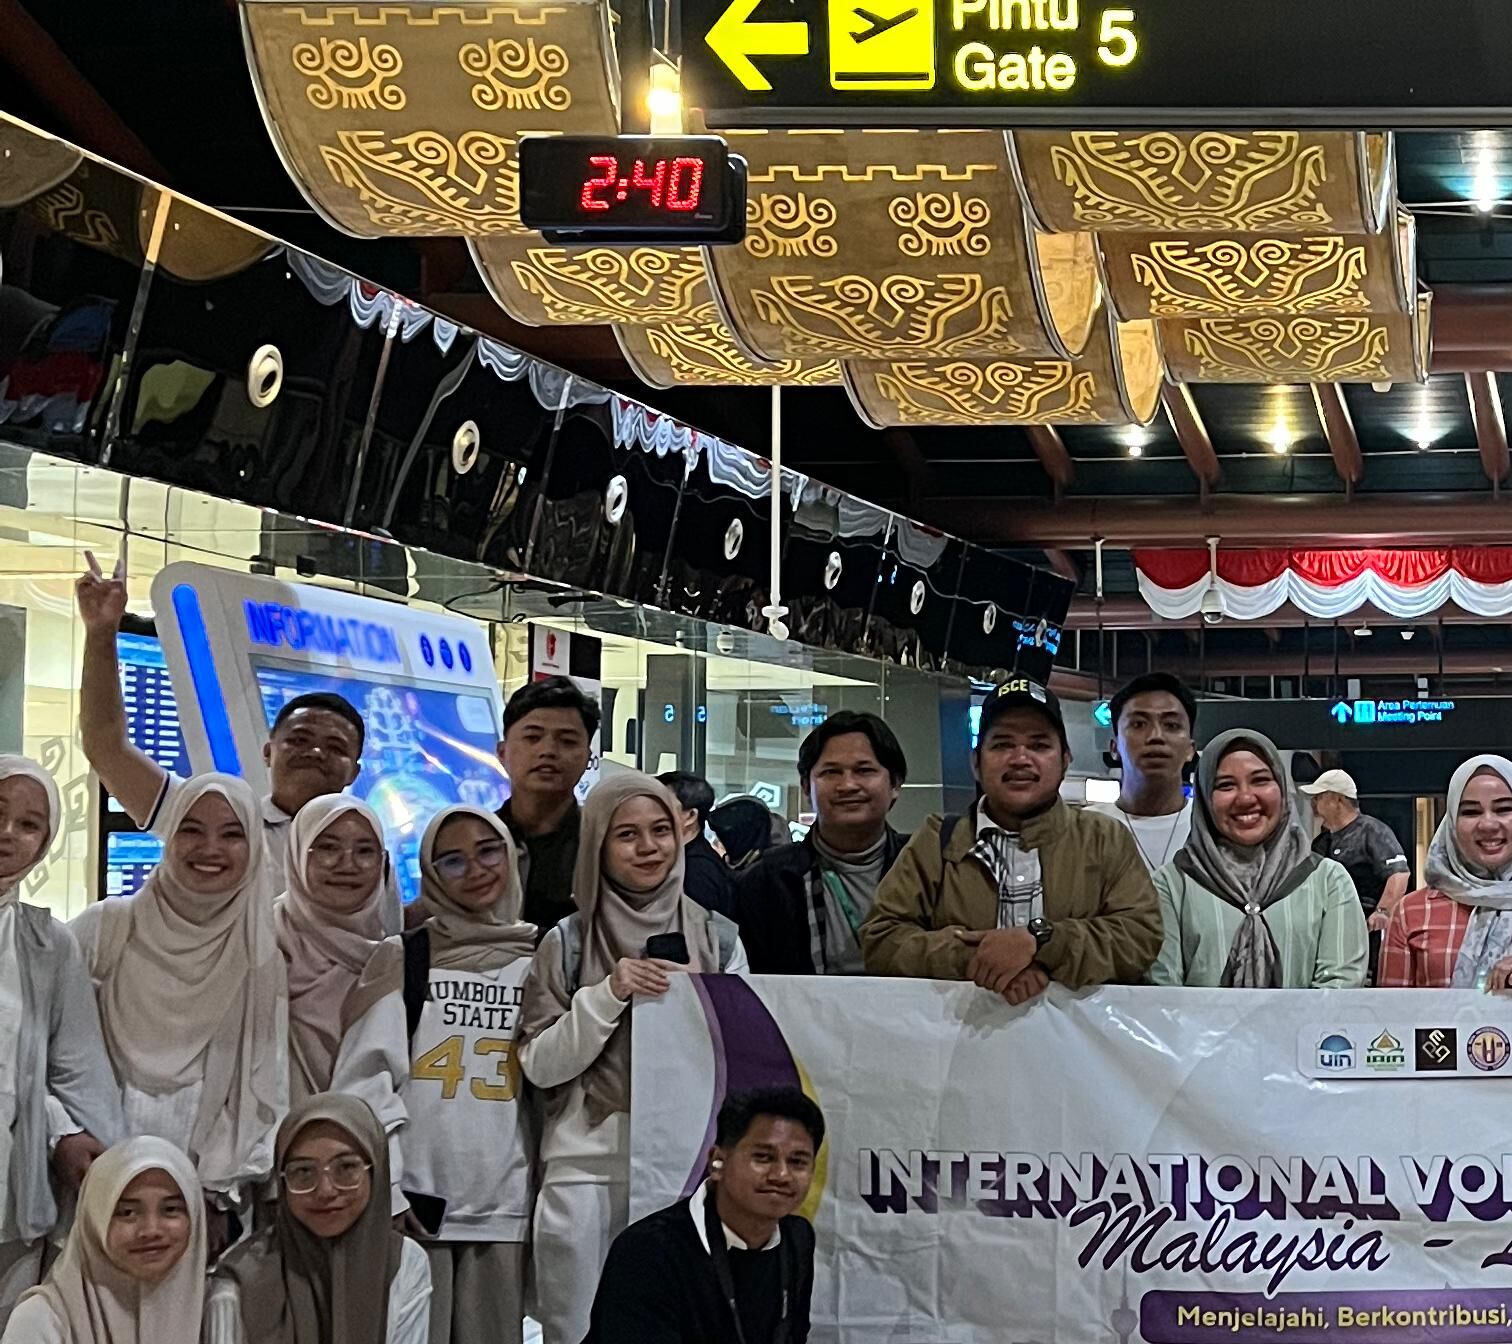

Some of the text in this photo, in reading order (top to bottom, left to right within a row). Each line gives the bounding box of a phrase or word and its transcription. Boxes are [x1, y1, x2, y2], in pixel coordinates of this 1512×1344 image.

[1096, 8, 1139, 67] 5
[953, 41, 1077, 91] Gate
[580, 155, 704, 210] 2:40
[1417, 711, 1442, 722] Point
[442, 1002, 513, 1031] STATE
[410, 1034, 518, 1102] 43
[858, 1147, 1396, 1219] INTERNATIONAL
[1069, 1201, 1390, 1295] Malaysia
[1177, 1305, 1330, 1332] Menjelajahi,
[1337, 1303, 1512, 1328] Berkontribusi,
